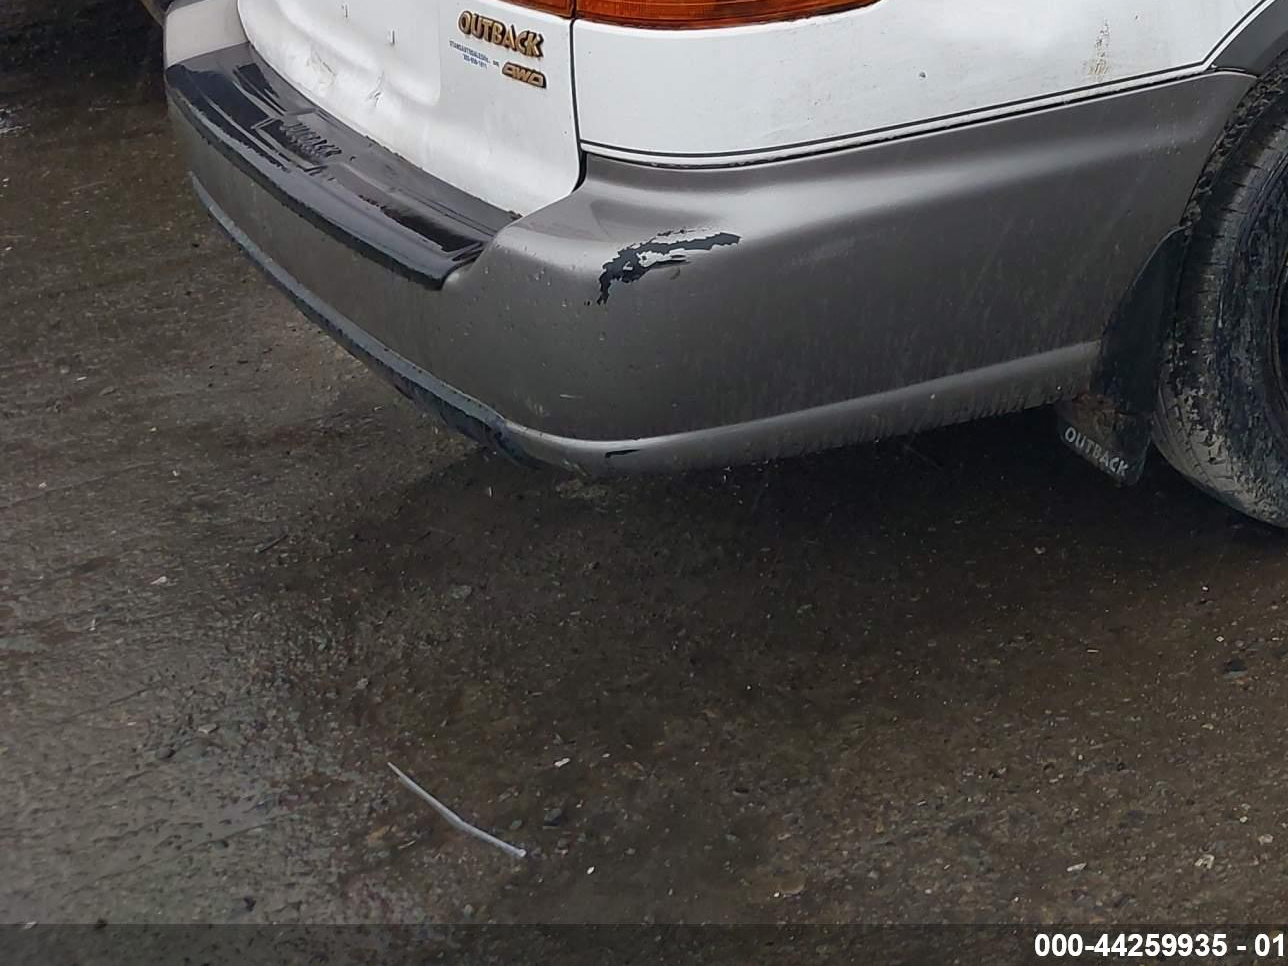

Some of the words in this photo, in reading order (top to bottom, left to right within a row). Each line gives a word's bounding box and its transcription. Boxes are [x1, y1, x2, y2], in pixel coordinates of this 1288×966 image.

[458, 10, 544, 58] OUTBACK
[501, 61, 547, 89] AWD
[1064, 426, 1128, 476] OUTBACK
